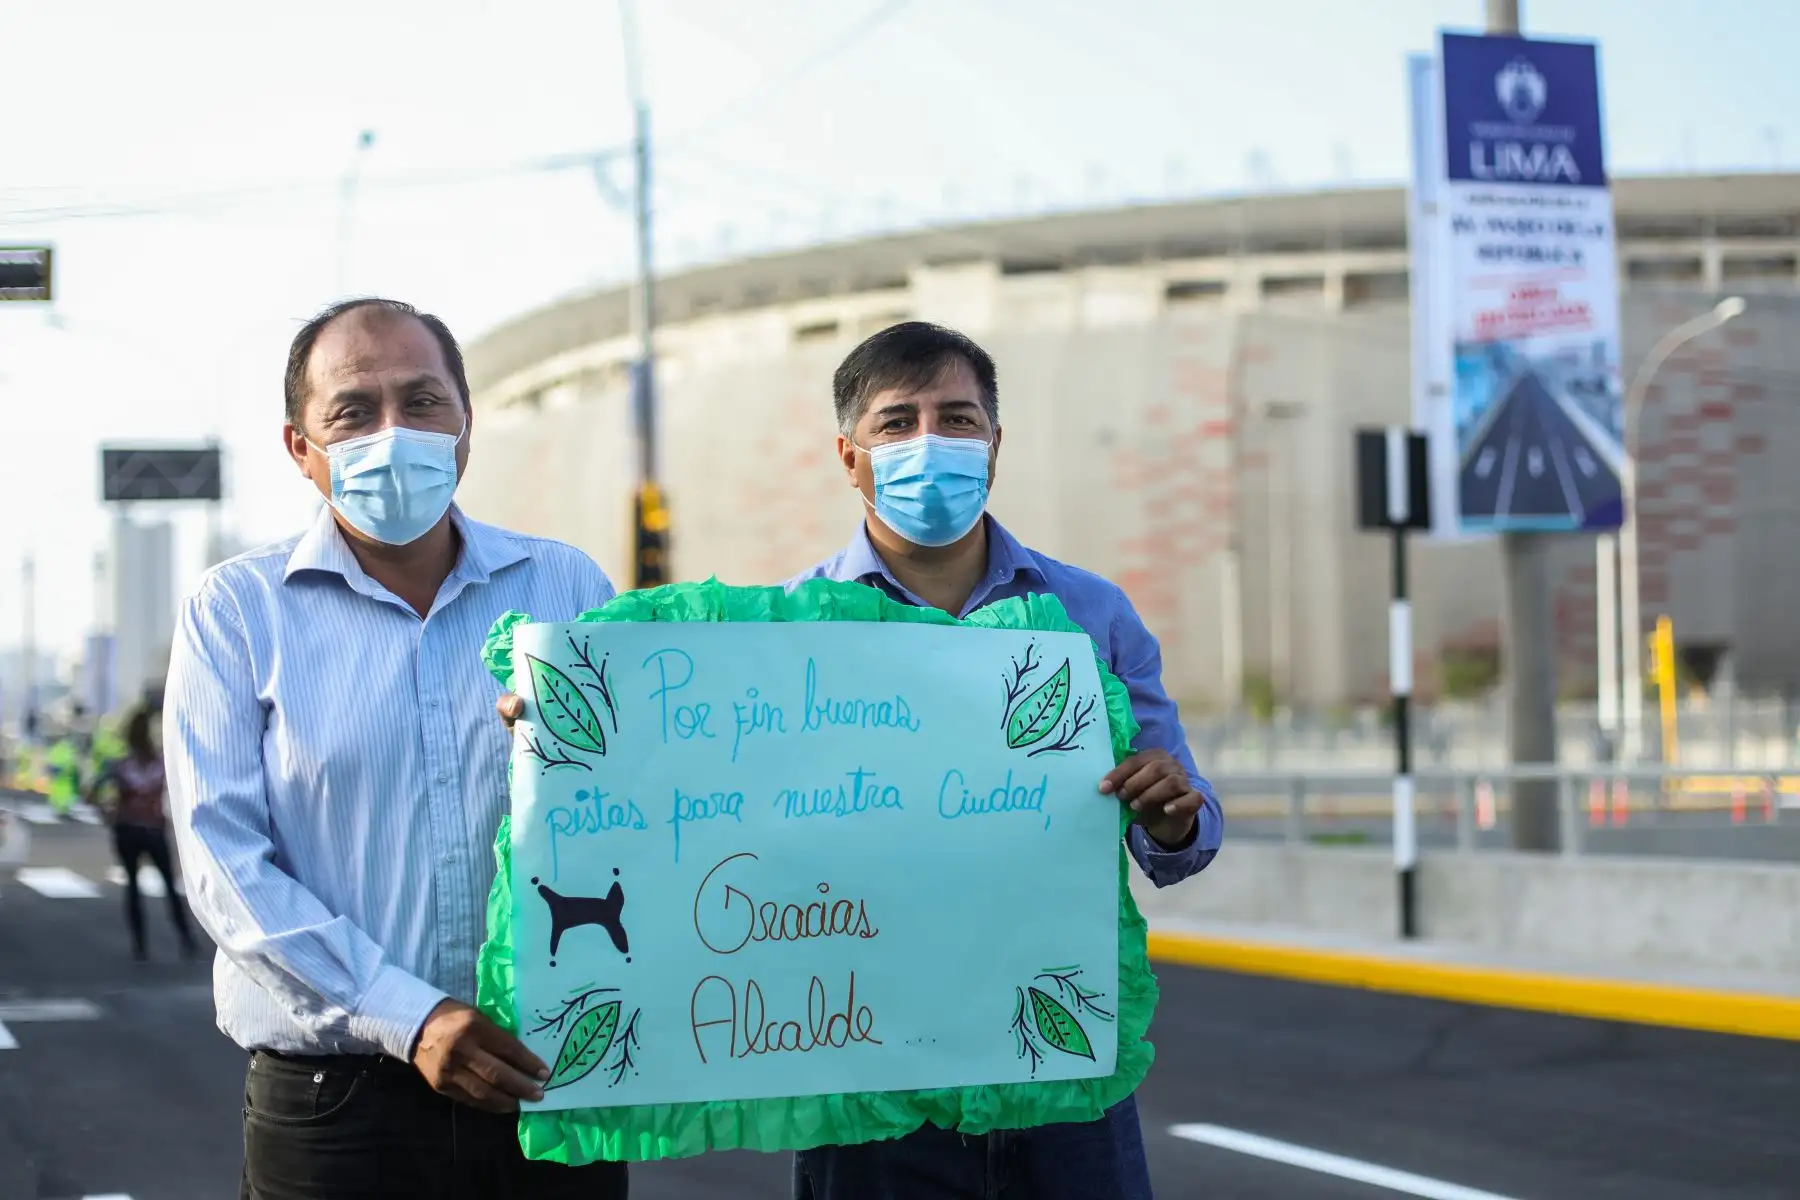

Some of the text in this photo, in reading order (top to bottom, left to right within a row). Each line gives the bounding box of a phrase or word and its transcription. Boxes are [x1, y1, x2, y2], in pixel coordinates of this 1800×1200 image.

[1469, 140, 1582, 184] LIMA
[641, 648, 921, 763] Por fin buenas
[544, 765, 1051, 883] pistas para nuestra Ciudad,
[693, 852, 880, 955] Gracias
[690, 970, 884, 1065] Alcalde
